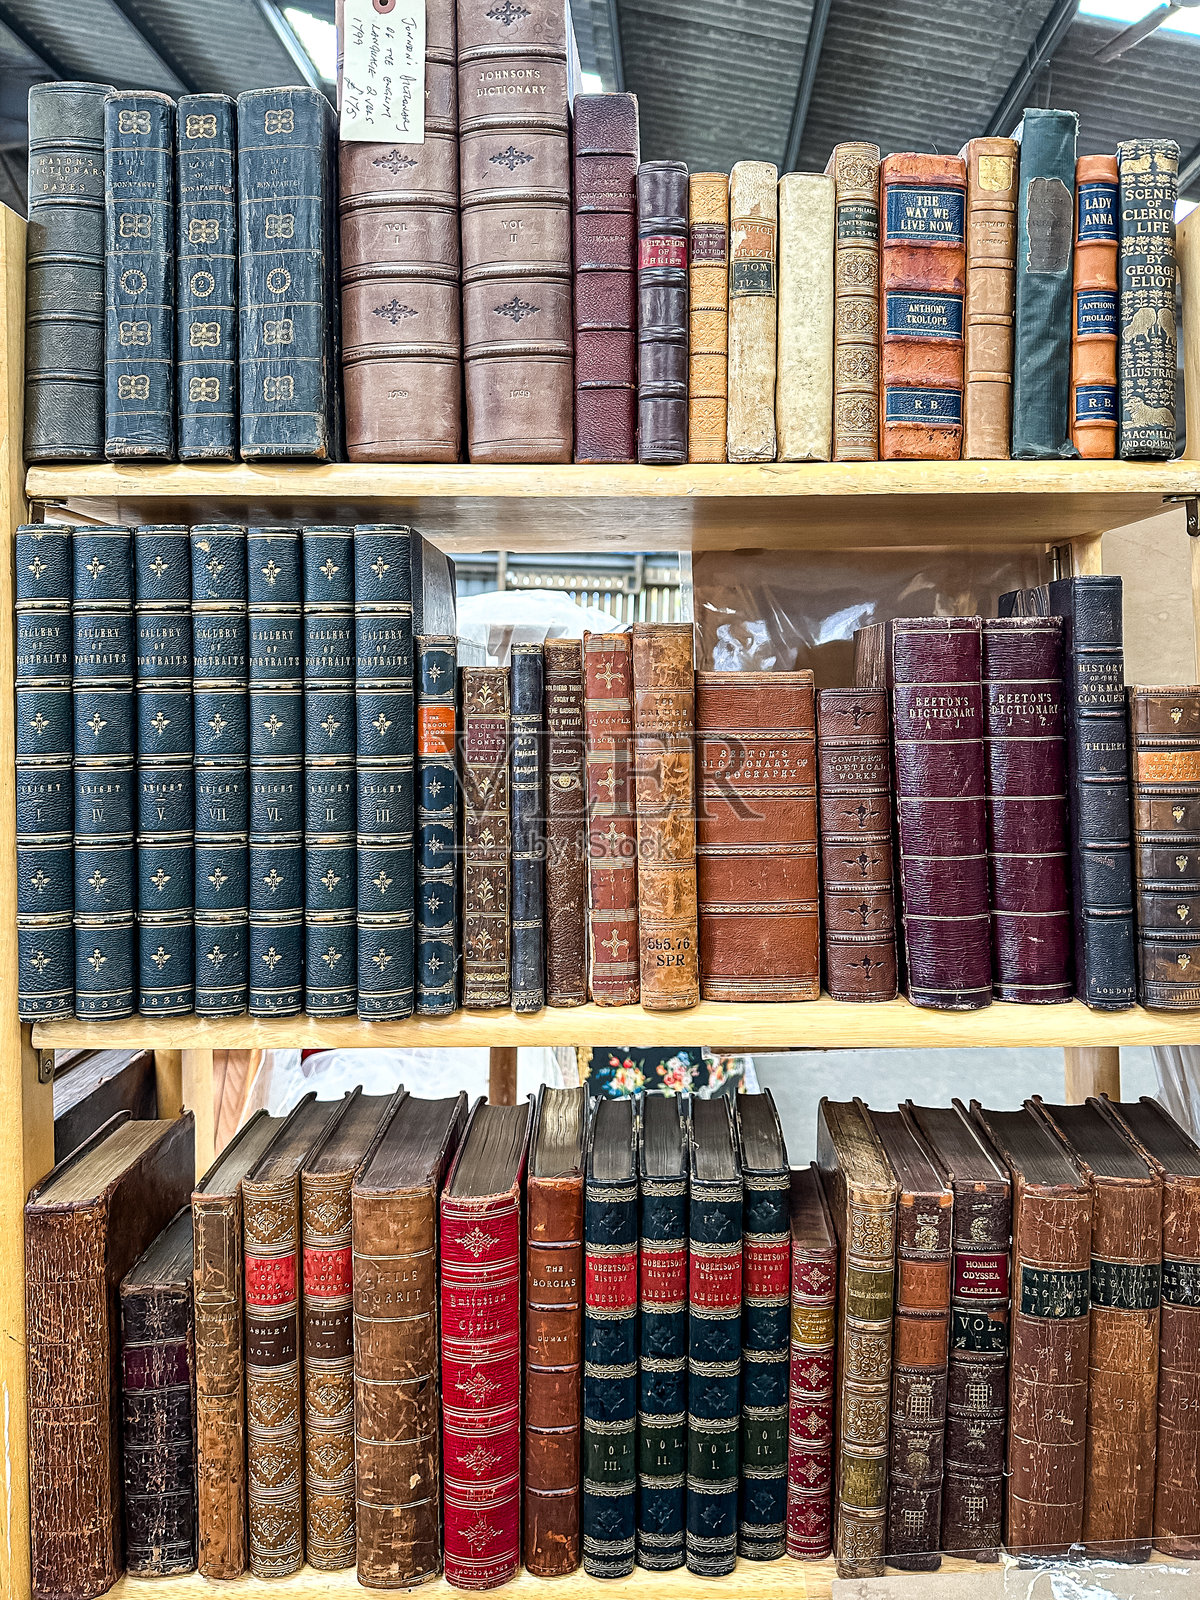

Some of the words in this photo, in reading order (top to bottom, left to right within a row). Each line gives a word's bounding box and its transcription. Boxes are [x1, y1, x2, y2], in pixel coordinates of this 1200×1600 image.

[480, 68, 541, 82] JOHNSON'S
[476, 85, 547, 97] DICTIONARY
[1125, 188, 1176, 202] SCENES
[916, 196, 940, 206] THE
[1085, 197, 1112, 210] LADY
[1146, 200, 1162, 208] OF
[840, 207, 876, 215] MEMORIALS
[906, 207, 928, 219] WAY
[934, 208, 950, 220] WE
[501, 220, 524, 229] VOL
[1085, 212, 1114, 227] ANNA
[385, 223, 408, 232] VOL
[901, 220, 926, 232] LIVE
[930, 220, 954, 232] NOW
[1136, 222, 1170, 234] LIFE
[509, 234, 518, 244] II
[643, 258, 682, 266] CHRIST
[1146, 254, 1166, 264] BY
[742, 264, 768, 272] TOM
[1125, 264, 1176, 278] GEORGE
[198, 280, 205, 289] 2
[1130, 276, 1173, 288] ELIOT
[908, 304, 946, 314] ANTHONY
[1082, 302, 1116, 311] ANTHONY
[906, 315, 948, 326] TROLLOPE
[510, 390, 530, 398] 1799
[914, 400, 926, 410] R.
[930, 400, 942, 410] B.
[1088, 398, 1102, 408] R.
[1104, 398, 1114, 408] B.
[1122, 438, 1140, 448] AND
[20, 627, 60, 638] GALLERY
[78, 628, 120, 638] GALLERY
[140, 628, 181, 638] GALLERY
[196, 628, 238, 639] GALLERY
[252, 630, 294, 640] GALLERY
[309, 630, 350, 640] GALLERY
[362, 630, 403, 640] GALLERY
[1078, 664, 1123, 672] HISTORY
[1082, 684, 1124, 692] NORMAN
[916, 696, 970, 707] BEETON'S
[998, 694, 1052, 704] BEETON'S
[909, 708, 976, 718] DICTIONARY
[990, 704, 1058, 715] DICTIONARY
[589, 718, 631, 727] JUVENILE
[925, 720, 932, 730] A
[1007, 717, 1013, 726] J
[720, 748, 789, 758] BEETON'S
[700, 759, 790, 768] DICTIONARY
[796, 759, 808, 768] OF
[830, 754, 882, 764] COWPER'S
[828, 764, 886, 772] POETICAL
[840, 772, 878, 780] WORKS
[36, 808, 45, 822] I.
[92, 808, 106, 822] IV.
[157, 808, 167, 820] V.
[208, 807, 230, 822] VII.
[266, 808, 282, 822] VI.
[324, 808, 338, 822] II.
[376, 808, 394, 824] III.
[648, 938, 690, 951] 595.76
[656, 954, 686, 966] SPR
[254, 1264, 281, 1272] LIFE
[748, 1263, 784, 1272] HISTORY
[966, 1260, 998, 1268] HOMERI
[365, 1270, 418, 1284] LITTLE
[594, 1274, 628, 1282] HISTORY
[648, 1270, 681, 1278] HISTORY
[700, 1272, 732, 1280] HISTORY
[962, 1271, 1000, 1280] ODYSSEA
[1032, 1272, 1083, 1284] ANNUAL
[533, 1278, 576, 1288] BORGIAS
[1092, 1276, 1158, 1288] REGISTER
[1024, 1285, 1088, 1298] REGISTER
[362, 1290, 421, 1304] DORRIT
[1030, 1302, 1081, 1316] 1792
[310, 1317, 349, 1326] ASHLEY
[959, 1316, 1002, 1332] VOL.
[250, 1326, 288, 1335] ASHLEY
[458, 1320, 500, 1338] Christ
[308, 1340, 336, 1349] VOL.
[250, 1346, 275, 1357] VOL.
[1178, 1398, 1200, 1412] 34
[746, 1430, 785, 1440] VOL.
[645, 1438, 683, 1450] VOL.
[697, 1443, 734, 1454] VOL.
[594, 1444, 631, 1455] VOL.
[756, 1446, 772, 1455] IV.
[603, 1460, 621, 1471] III.
[657, 1456, 672, 1466] II.
[712, 1460, 720, 1470] I.
